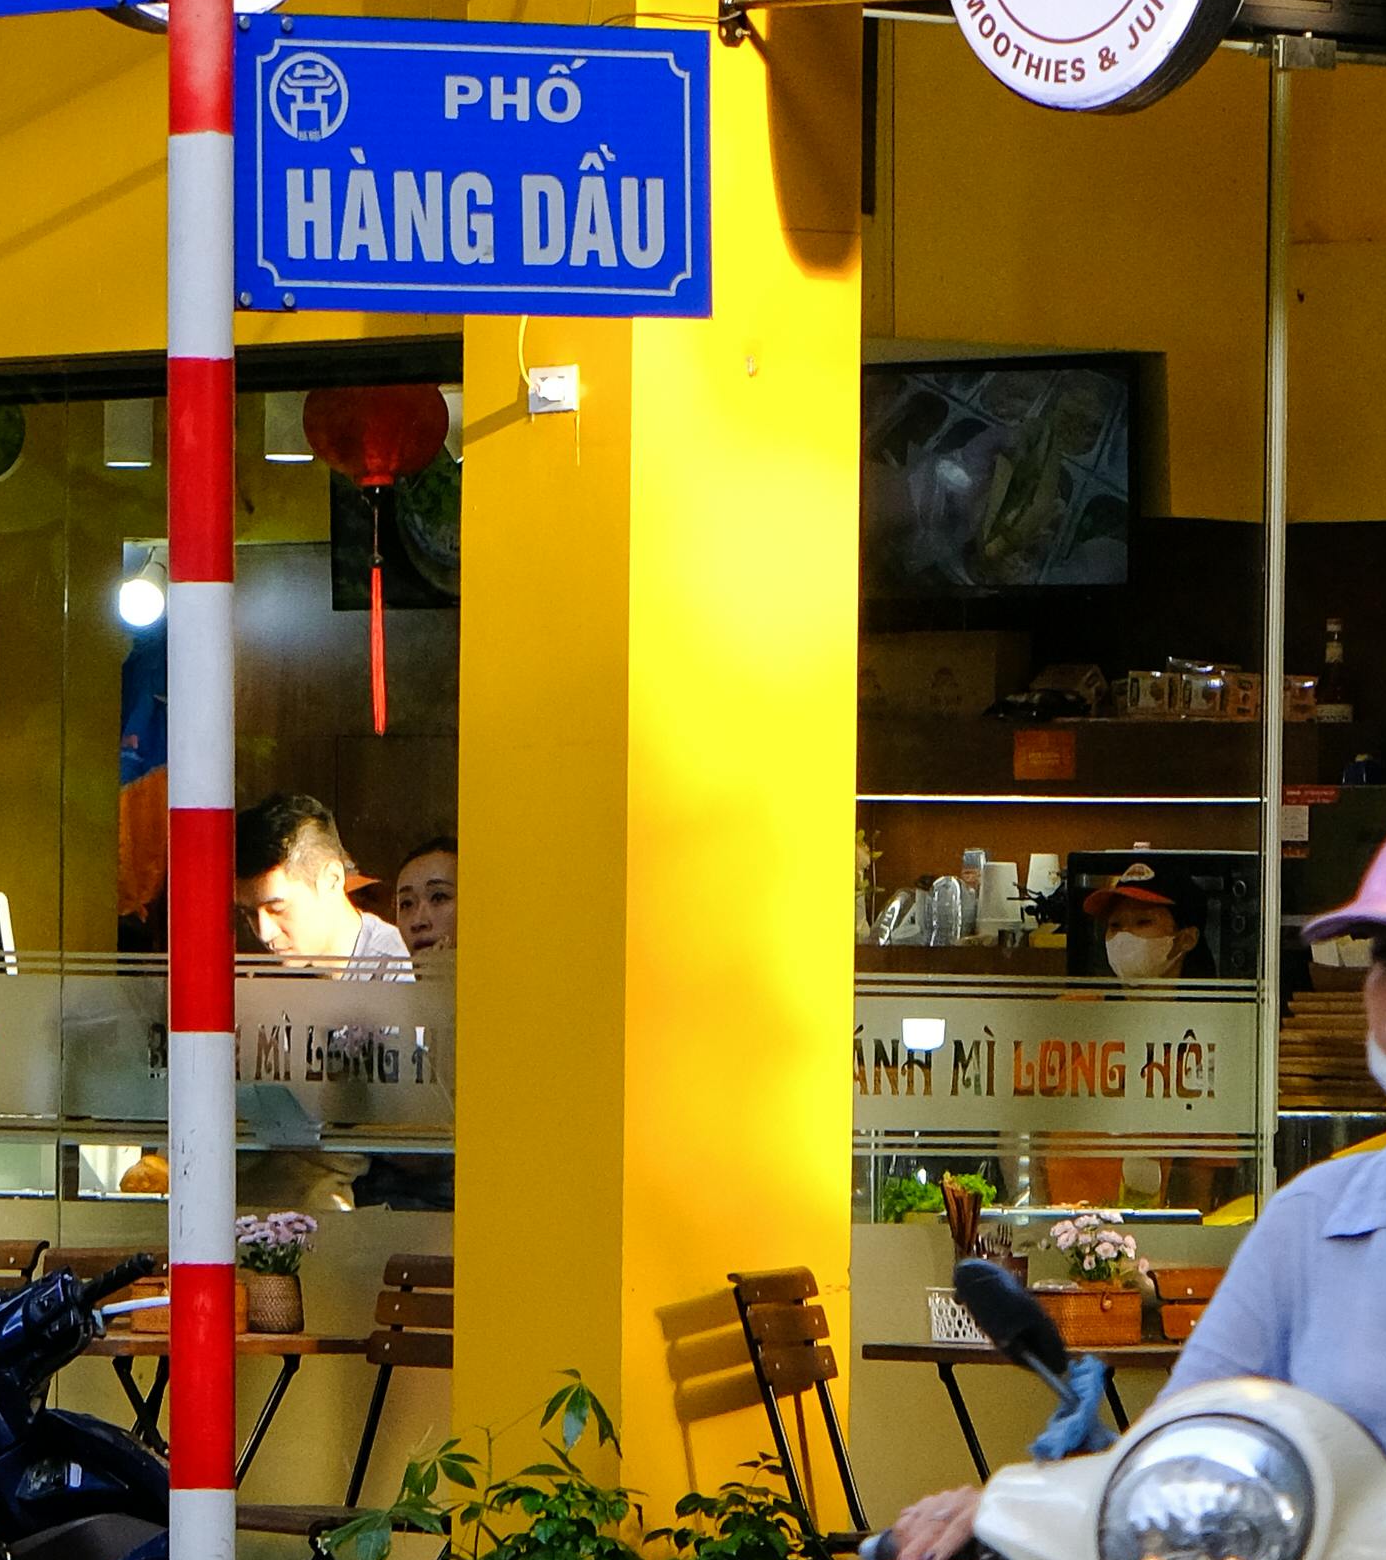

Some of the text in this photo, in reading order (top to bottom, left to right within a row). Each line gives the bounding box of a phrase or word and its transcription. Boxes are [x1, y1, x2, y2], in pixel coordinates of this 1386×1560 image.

[444, 58, 588, 122] PHỐ
[1099, 46, 1118, 73] &
[286, 142, 665, 269] HÀNG DẦU
[950, 1026, 995, 1097] MÌ
[1013, 1040, 1125, 1098] LONG
[1141, 1029, 1215, 1109] HỘI
